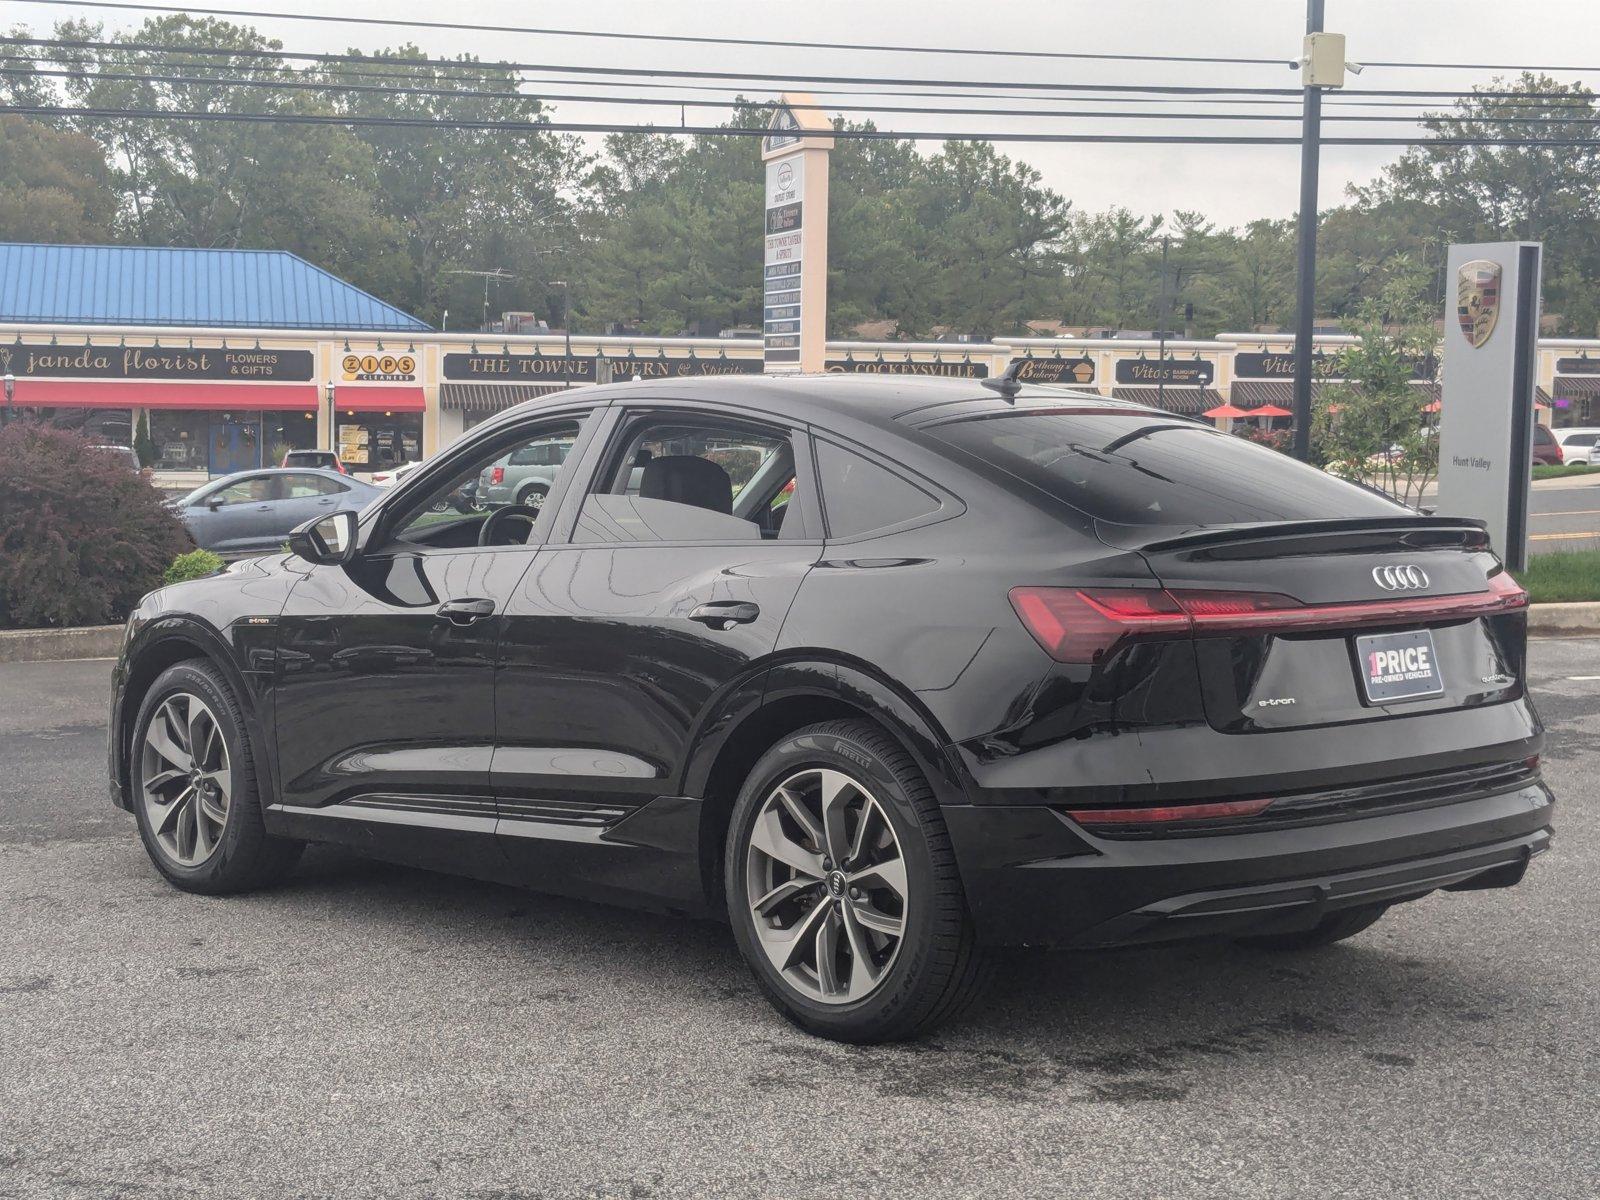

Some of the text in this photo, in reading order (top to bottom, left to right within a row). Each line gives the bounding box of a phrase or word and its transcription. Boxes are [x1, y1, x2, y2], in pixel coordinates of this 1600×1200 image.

[27, 349, 211, 375] janda florist
[225, 354, 278, 364] FLOWERS
[344, 356, 414, 373] ZIPS
[469, 358, 510, 373] THE
[519, 359, 589, 375] TOWNE
[612, 361, 669, 376] AVERN
[678, 362, 691, 376] &
[231, 366, 273, 375] & GIFTS
[1452, 455, 1491, 471] Hunt Valley
[1371, 669, 1432, 685] PRE-OWNED VEHICLES
[1258, 698, 1296, 707] e-tron
[833, 740, 873, 769] PIRELLI
